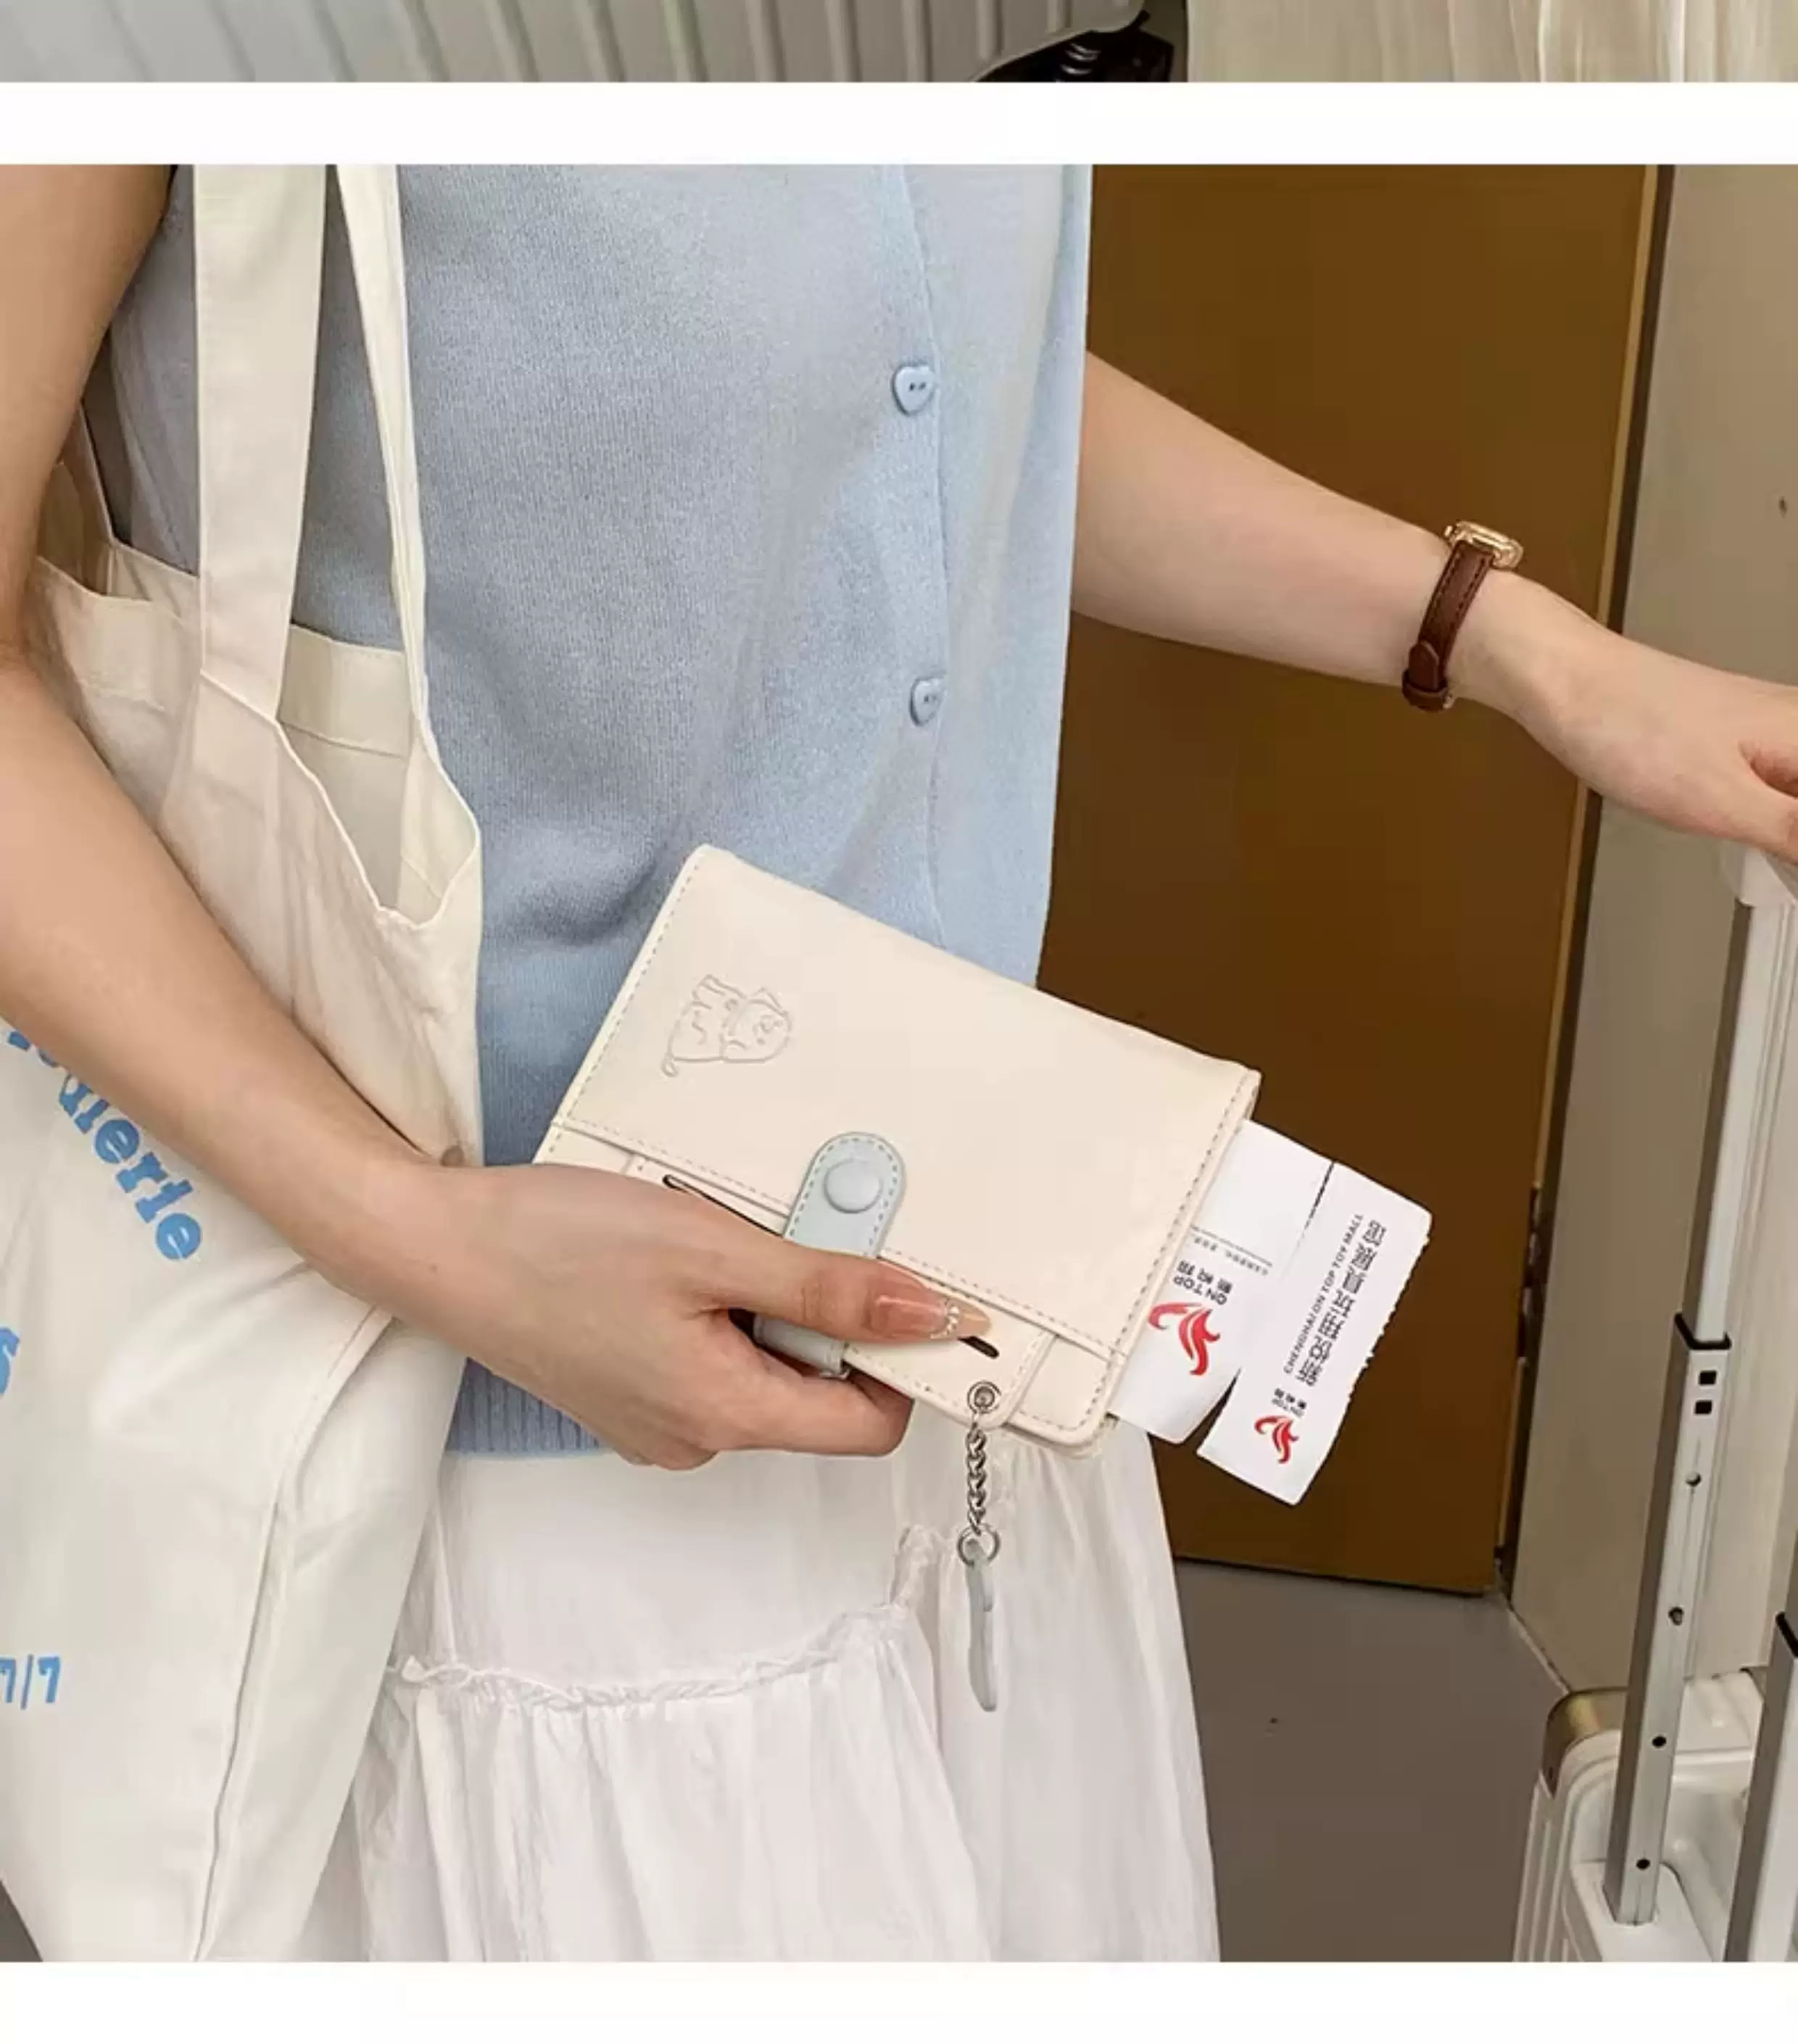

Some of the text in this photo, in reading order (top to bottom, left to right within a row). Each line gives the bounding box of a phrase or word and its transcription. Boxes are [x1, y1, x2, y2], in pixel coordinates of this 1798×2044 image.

[1321, 1270, 1335, 1293] TOP
[1332, 1245, 1347, 1268] TOY
[1343, 1215, 1363, 1245] MALL
[1173, 1276, 1227, 1305] ON TOP
